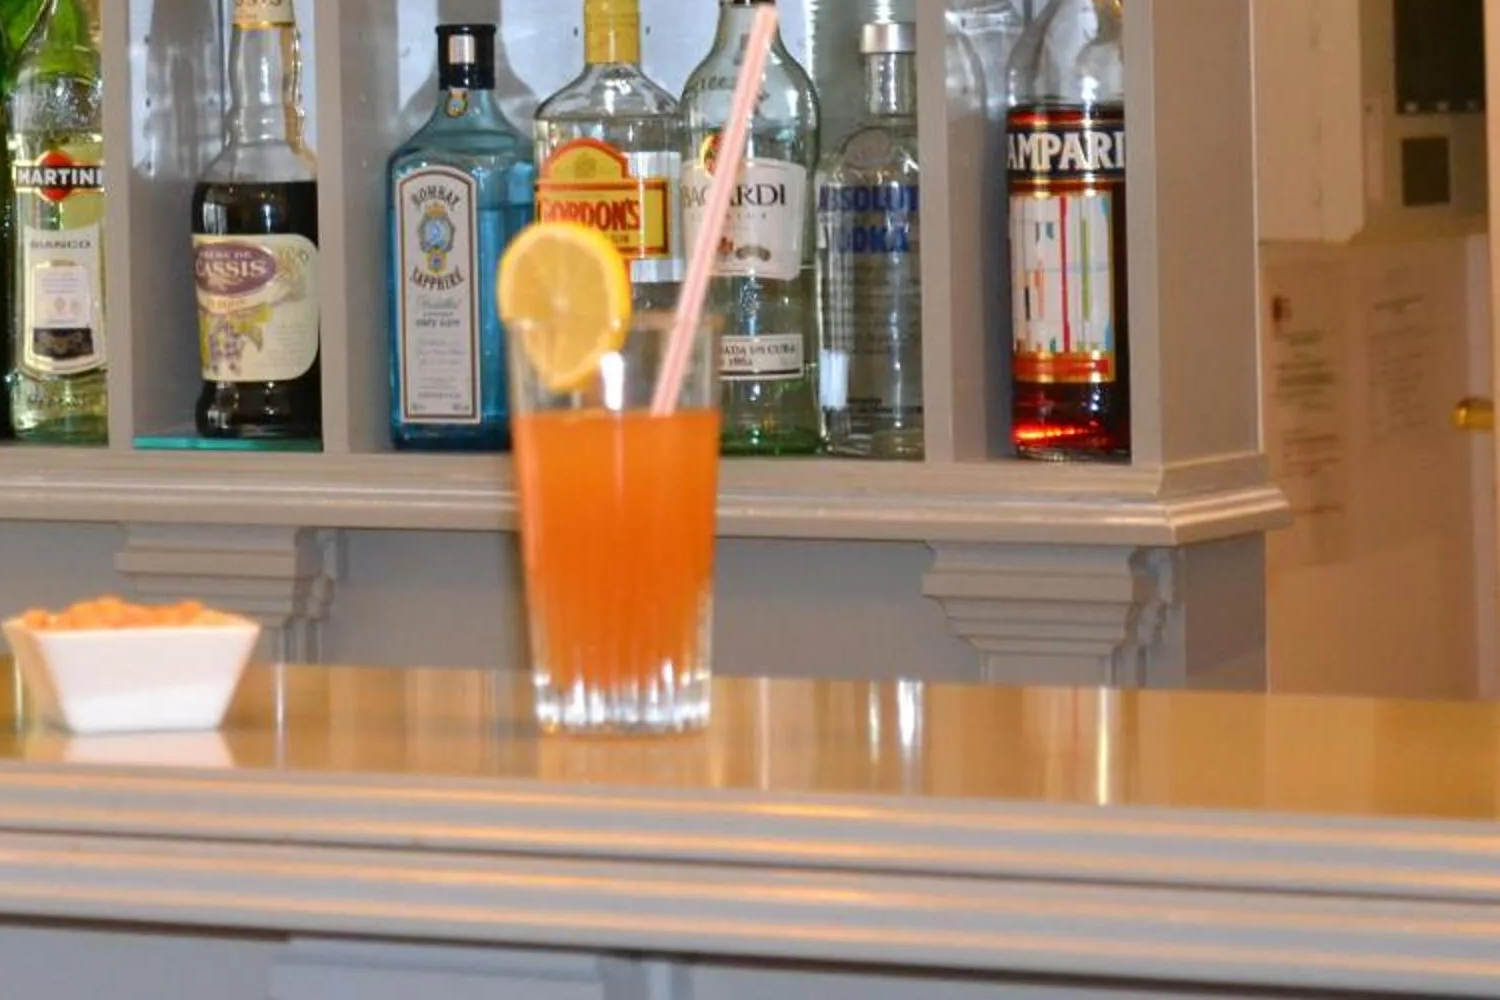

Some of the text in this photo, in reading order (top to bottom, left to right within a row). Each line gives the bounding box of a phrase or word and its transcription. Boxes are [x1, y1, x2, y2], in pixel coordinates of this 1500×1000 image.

[1007, 131, 1125, 172] AMPARI
[411, 185, 461, 211] BOMBAY
[681, 182, 786, 208] BACRDI
[826, 226, 910, 254] ODKA
